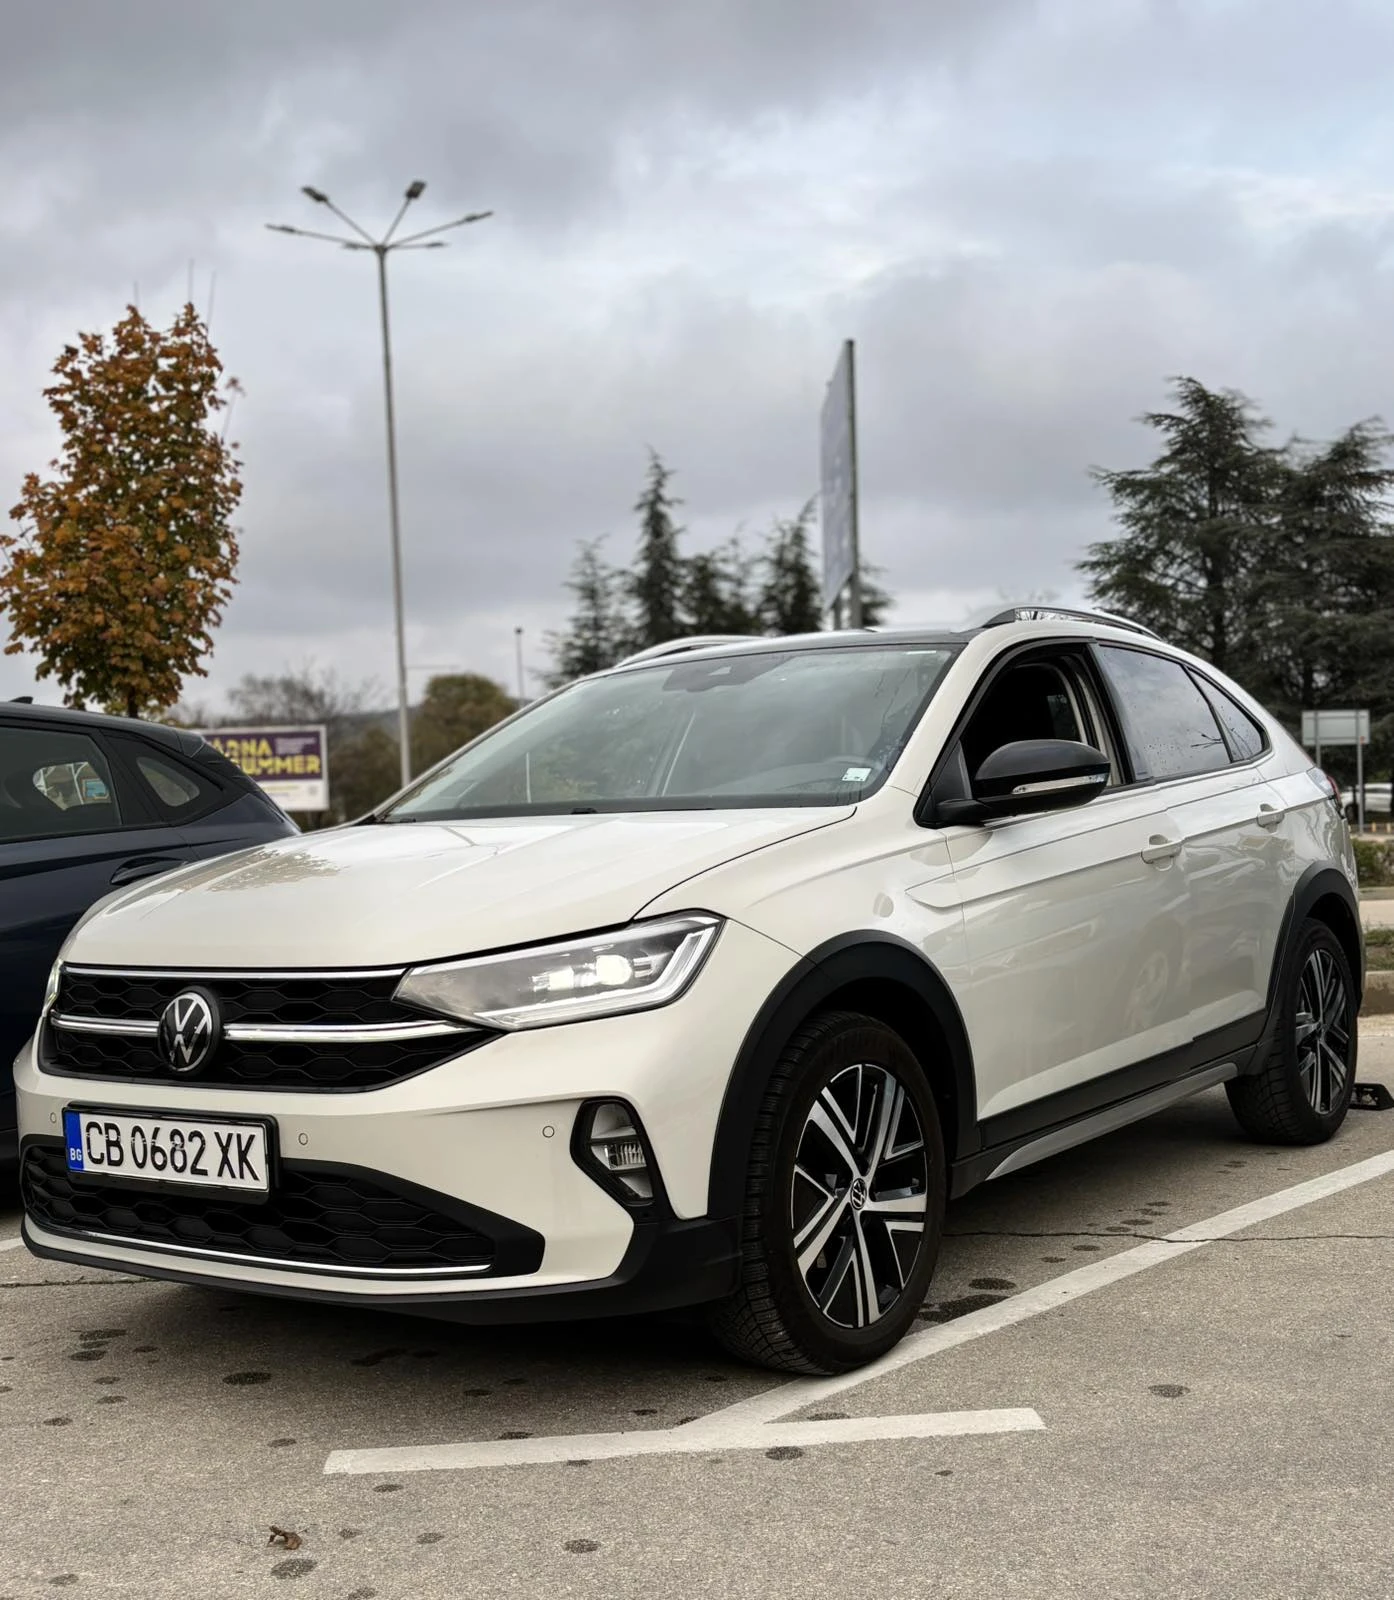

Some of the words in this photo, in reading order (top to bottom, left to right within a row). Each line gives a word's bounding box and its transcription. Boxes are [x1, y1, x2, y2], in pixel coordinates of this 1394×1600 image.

[210, 738, 273, 757] ARNA
[69, 1148, 83, 1162] BG
[85, 1121, 124, 1167] CB
[130, 1125, 209, 1177] 0682
[213, 1131, 261, 1182] XK
